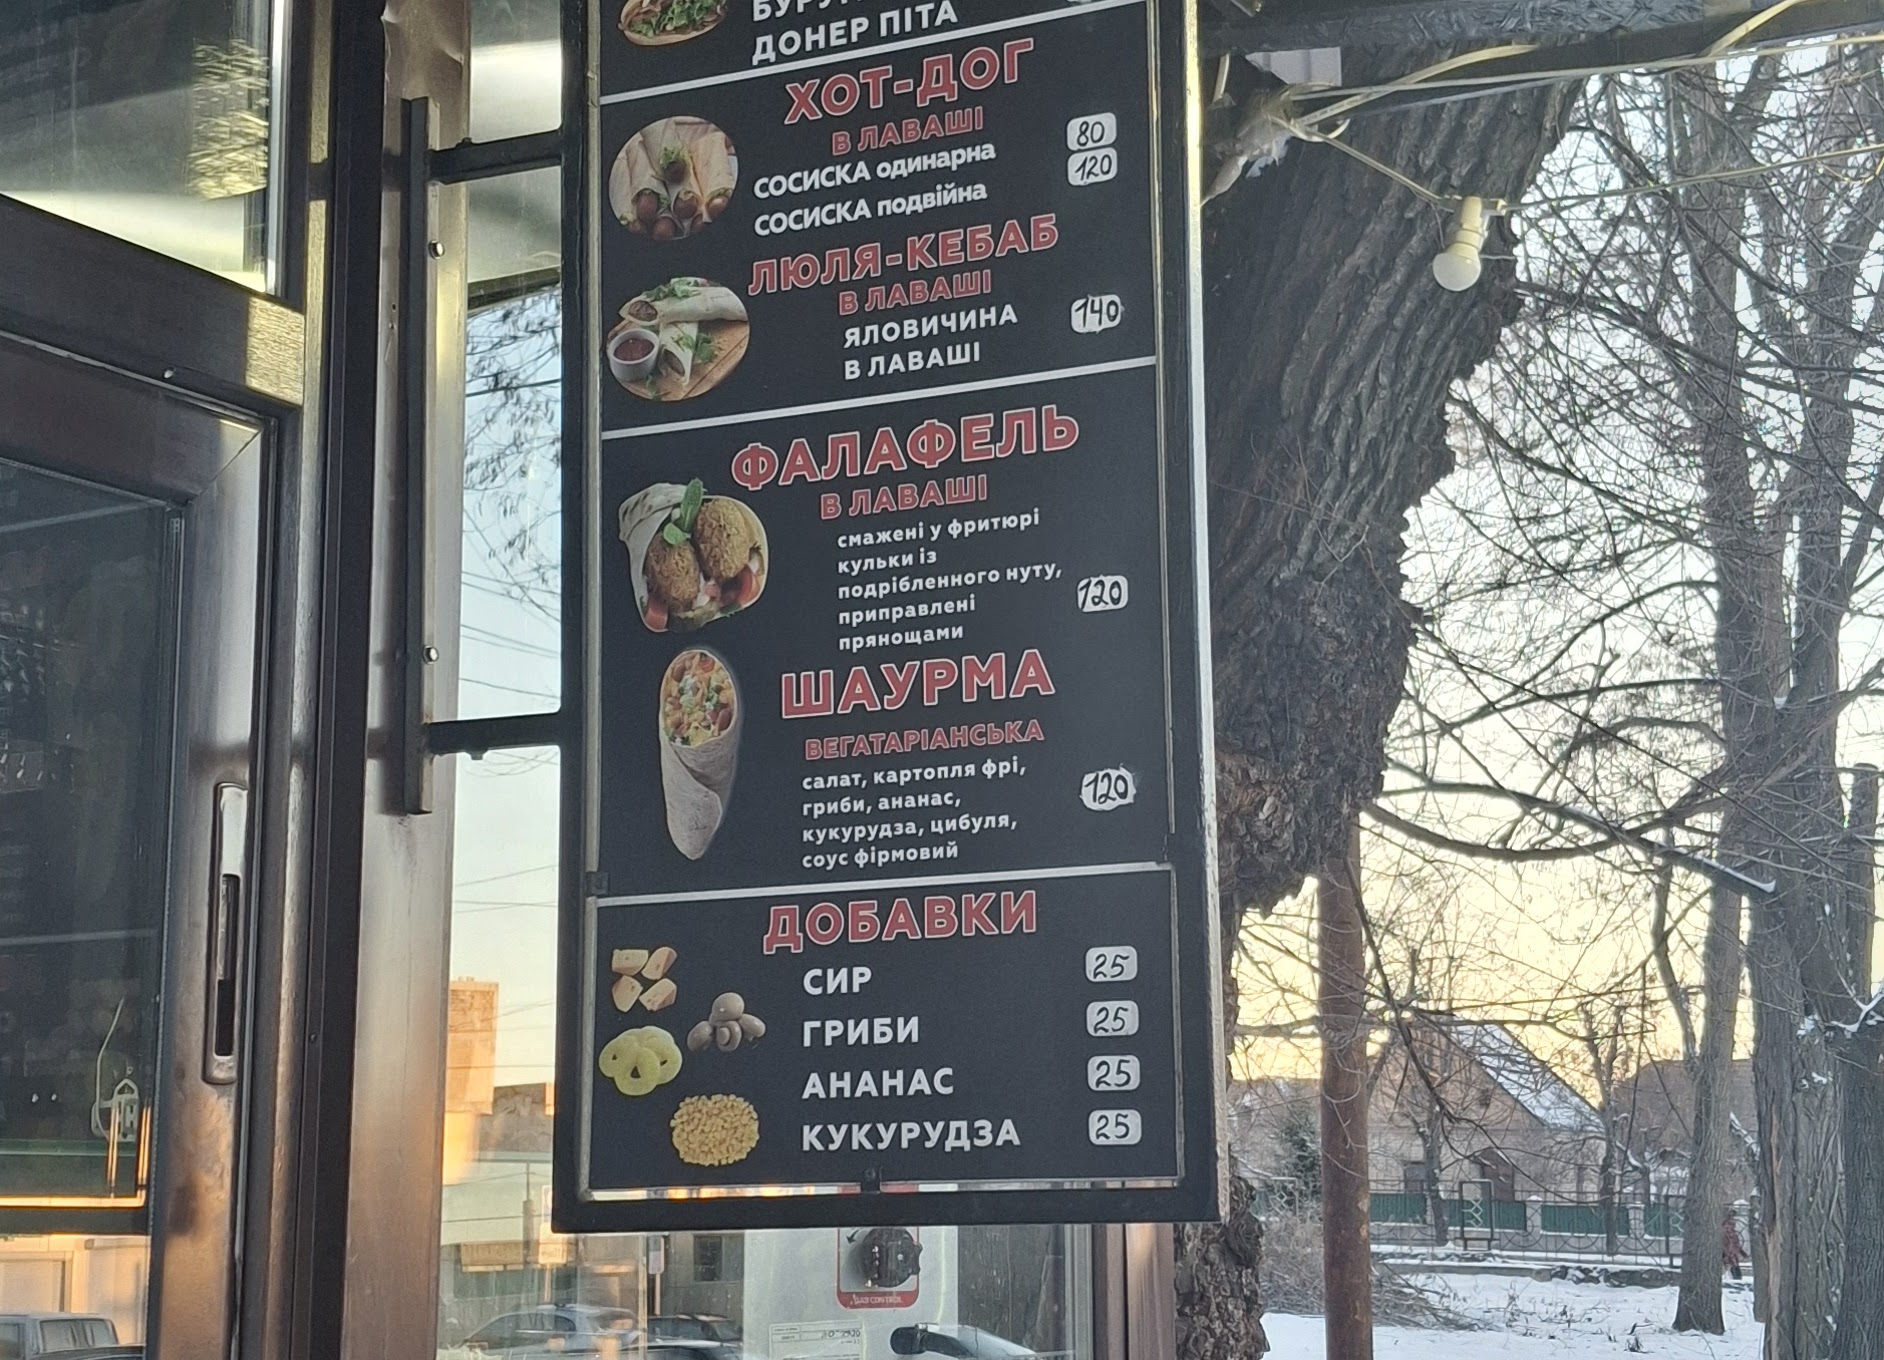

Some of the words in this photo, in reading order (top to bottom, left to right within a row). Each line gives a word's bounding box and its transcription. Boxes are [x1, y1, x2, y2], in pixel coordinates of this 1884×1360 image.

[752, 19, 869, 65] ДОНЕР
[879, 0, 958, 36] ПІТА
[784, 38, 1034, 124] ХОТ-ДОГ
[832, 131, 852, 156] В
[857, 106, 984, 152] ЛАВАШІ
[1076, 121, 1105, 147] 80
[754, 161, 871, 199] СОСИСКА
[876, 143, 996, 182] одинарна
[1075, 153, 1112, 183] 120
[754, 199, 871, 237] СОСИСКА
[877, 180, 987, 219] подвійна
[747, 213, 1059, 296] ЛЮЛЯ-КЕБАБ
[838, 290, 858, 315] В
[862, 270, 992, 312] ЛАВАШІ
[844, 304, 1018, 348] ЯЛОВИЧИНА
[1073, 298, 1119, 330] 140
[844, 360, 860, 380] В
[867, 342, 980, 376] ЛАВАШІ
[731, 404, 1080, 491] ФАЛАФЕЛЬ
[820, 494, 840, 520] В
[849, 475, 988, 517] ЛАВАШІ
[837, 522, 924, 549] смажені
[929, 525, 941, 541] у
[947, 508, 1040, 541] фритюрі
[837, 551, 913, 575] кульки
[919, 548, 937, 565] із
[838, 569, 1000, 600] подрібленного
[1006, 561, 1063, 584] нуту,
[1080, 578, 1122, 610] 120
[838, 594, 976, 626] приправлені
[839, 623, 963, 652] прянощами
[781, 649, 1055, 719] ШАУРМА
[805, 719, 1044, 760] ВЕГАТАРІАНСЬКА
[802, 770, 867, 793] салат,
[873, 763, 976, 787] картопля
[981, 756, 1026, 781] фрі,
[1085, 771, 1128, 803] 120
[803, 792, 871, 819] гриби,
[878, 790, 961, 811] ананас,
[802, 818, 924, 845] кукурудза,
[931, 811, 1017, 835] цибуля,
[802, 848, 849, 870] соус
[854, 841, 959, 866] фірмовий
[763, 890, 1037, 955] ДОБАВКИ
[803, 966, 873, 996] СИР
[1093, 953, 1130, 980] 25
[803, 1016, 920, 1047] ГРИБИ
[1093, 1006, 1130, 1033] 25
[802, 1066, 955, 1100] АНАНАС
[1095, 1060, 1131, 1088] 25
[802, 1118, 1020, 1152] КУКУРУДЗА
[1096, 1115, 1130, 1140] 25
